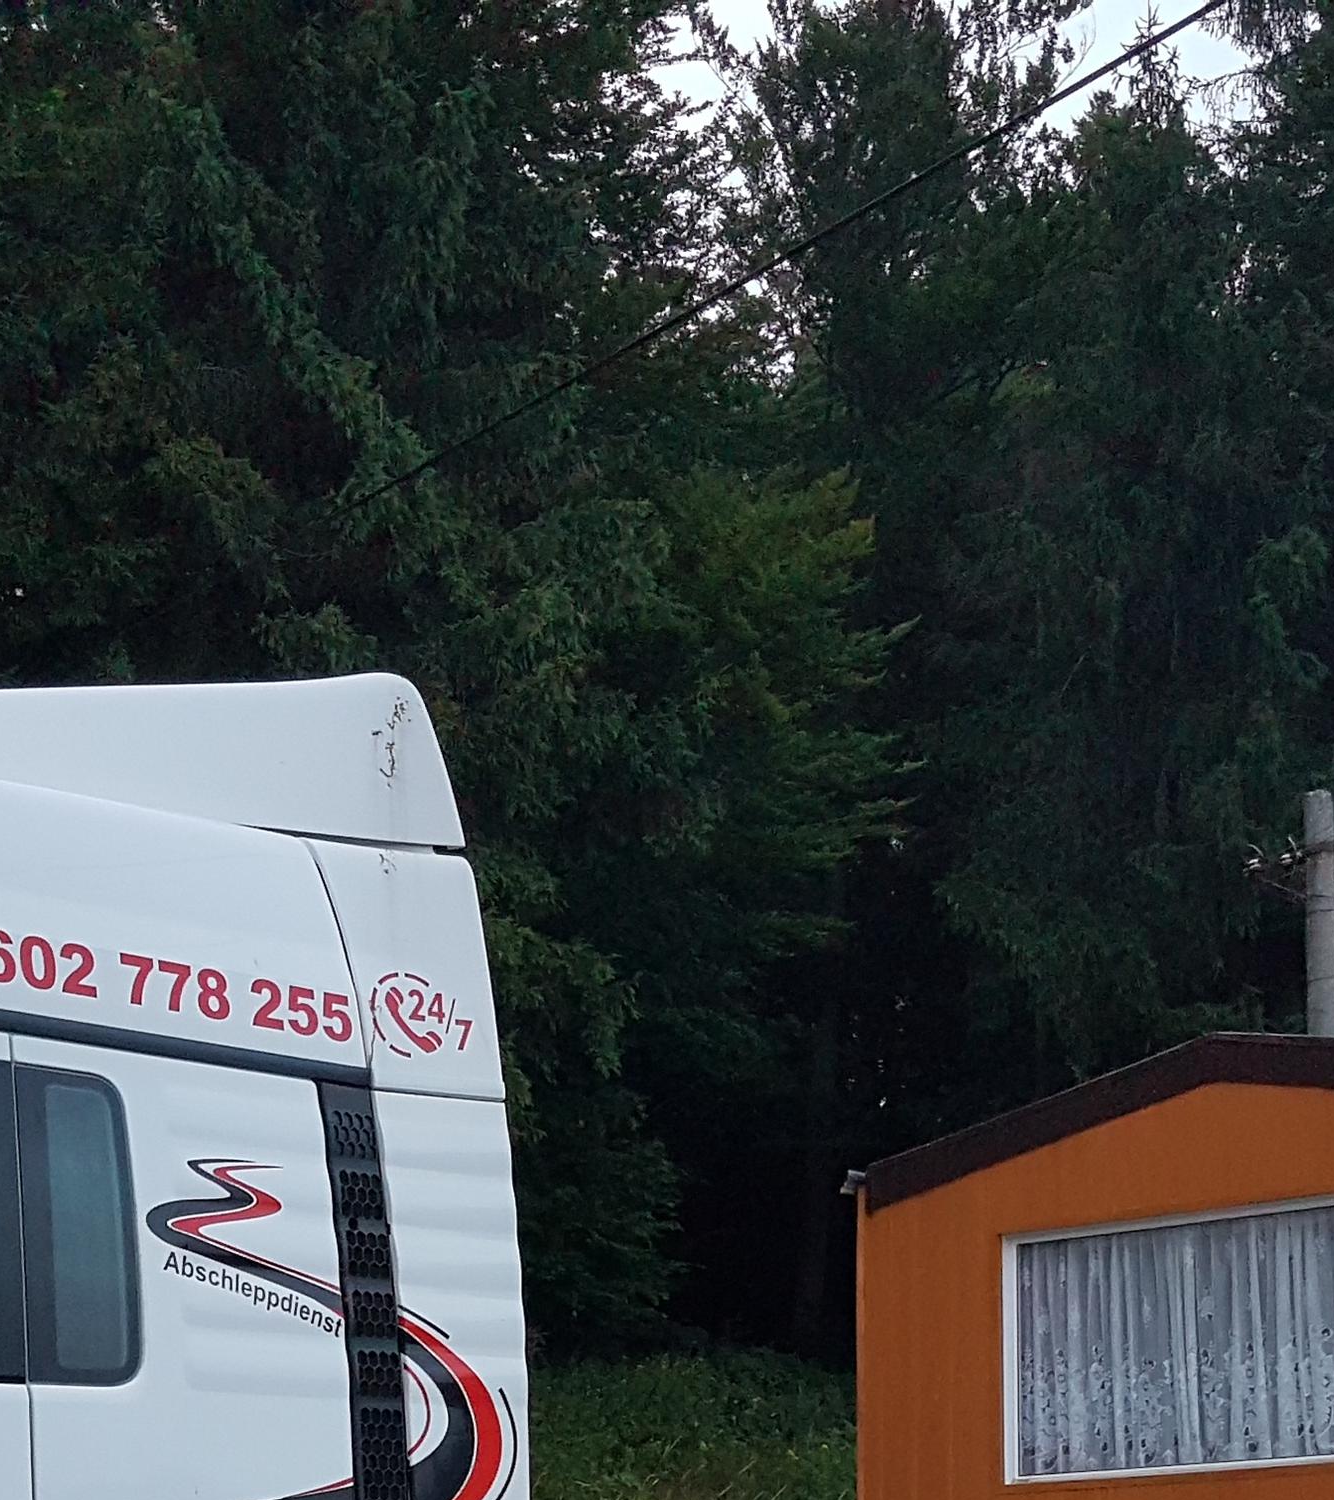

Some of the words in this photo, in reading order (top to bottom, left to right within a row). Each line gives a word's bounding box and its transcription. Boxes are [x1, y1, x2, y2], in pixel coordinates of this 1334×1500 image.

[119, 953, 230, 1020] 778
[252, 979, 353, 1042] 255
[409, 990, 473, 1051] 24/7
[163, 1251, 344, 1338] Abschleppdienst
